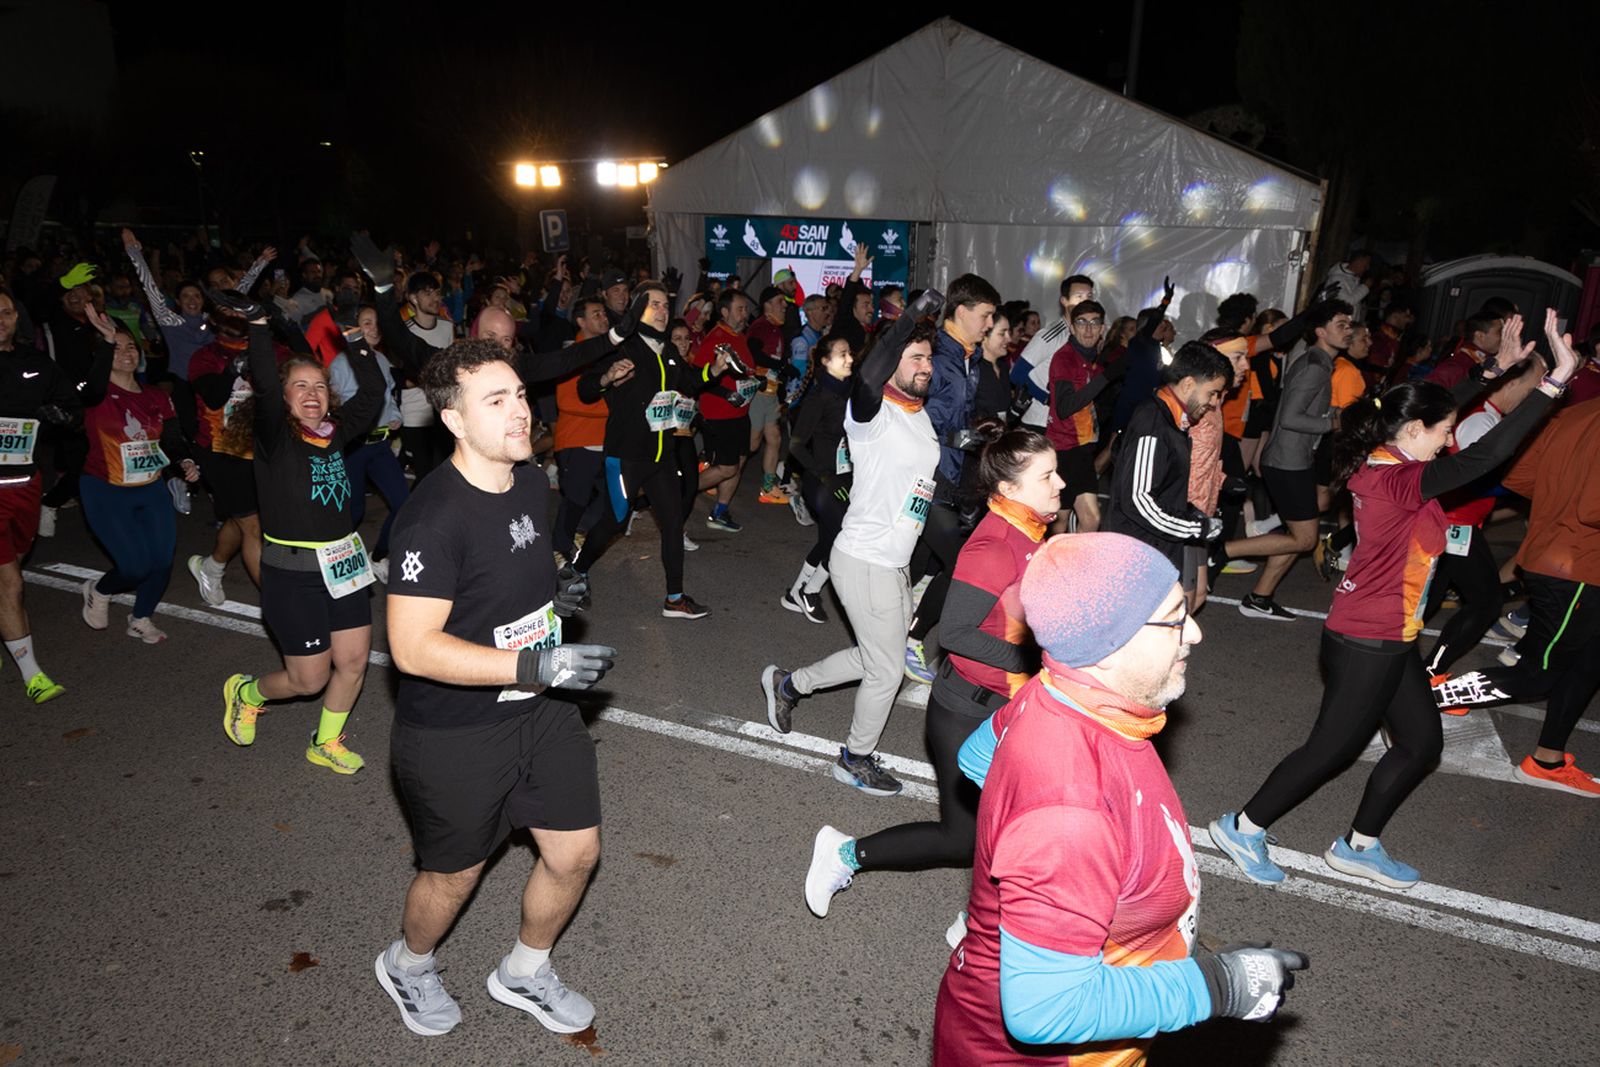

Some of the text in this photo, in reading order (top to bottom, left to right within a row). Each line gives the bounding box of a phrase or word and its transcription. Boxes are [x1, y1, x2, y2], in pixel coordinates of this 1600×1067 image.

[547, 215, 562, 238] P
[780, 224, 830, 241] 43 SAN
[776, 238, 827, 257] ANTÓN
[330, 552, 365, 579] 12300
[513, 622, 536, 637] NOCHE
[537, 618, 545, 628] DE
[507, 628, 546, 650] SAN ANTÓN
